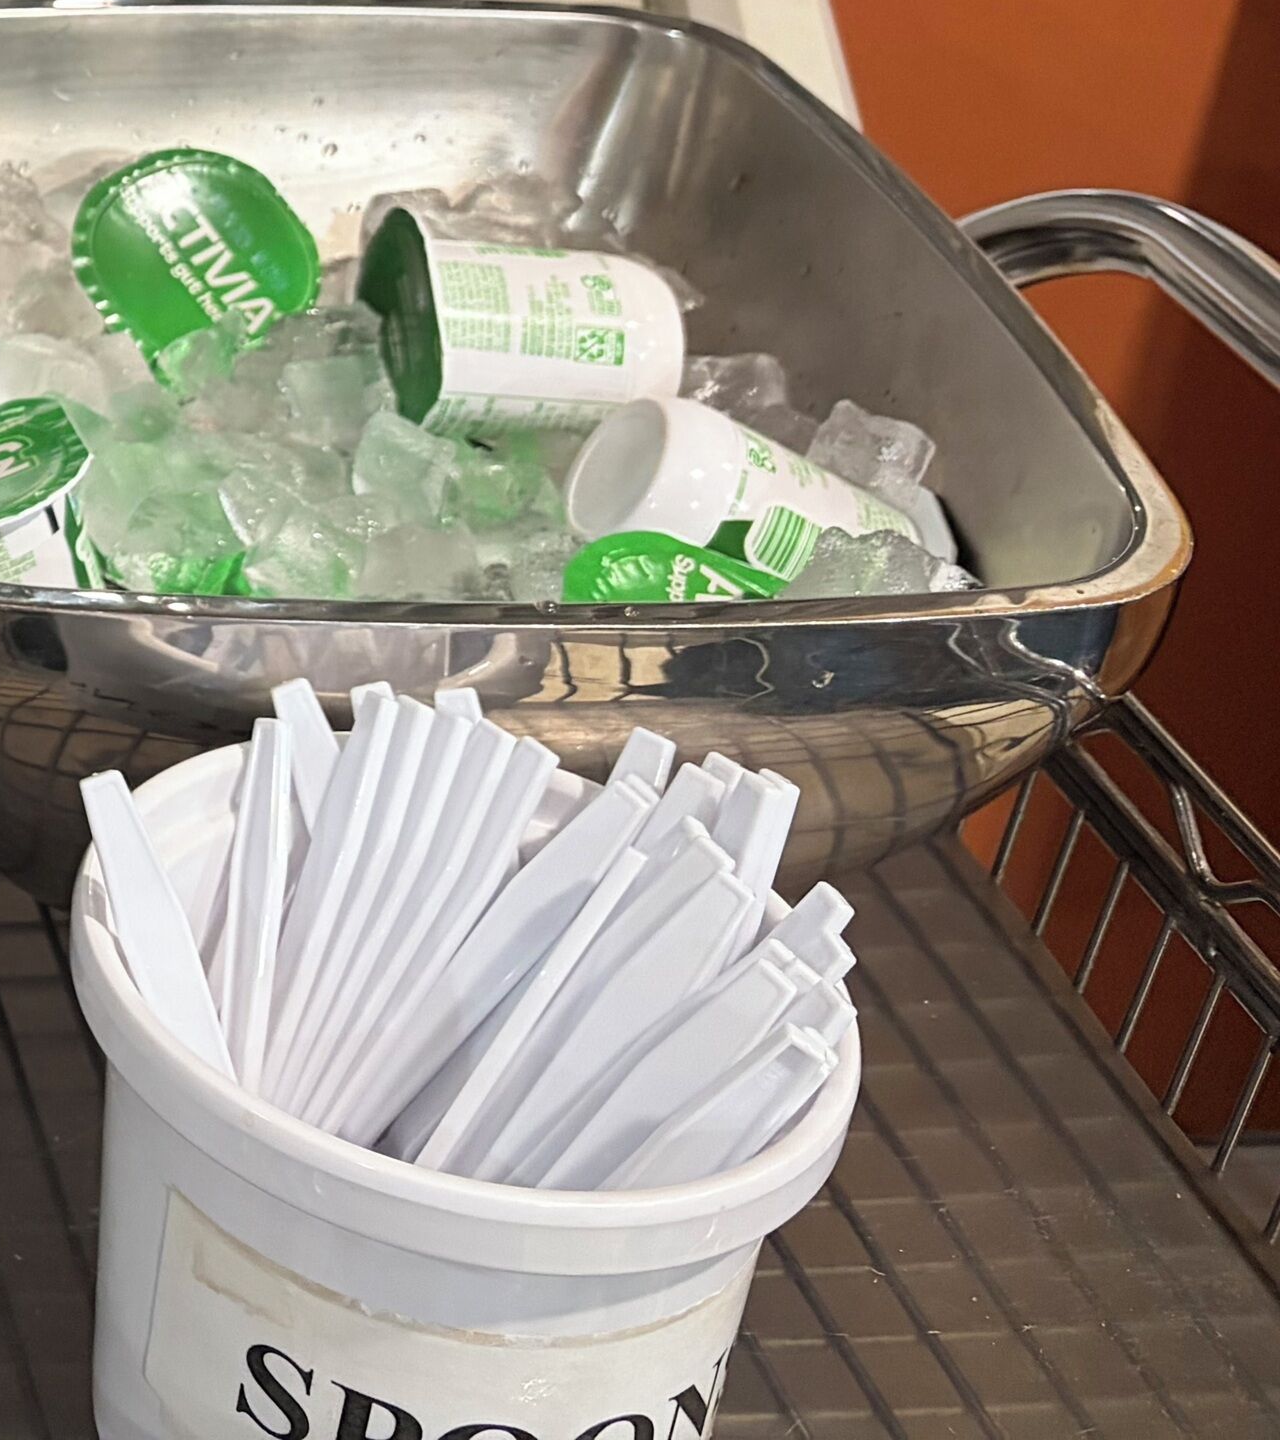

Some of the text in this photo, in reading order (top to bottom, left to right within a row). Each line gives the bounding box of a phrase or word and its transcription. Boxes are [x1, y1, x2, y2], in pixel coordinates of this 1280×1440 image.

[138, 172, 276, 335] CTIVIA
[169, 262, 204, 296] gut
[235, 1343, 730, 1439] SPN
